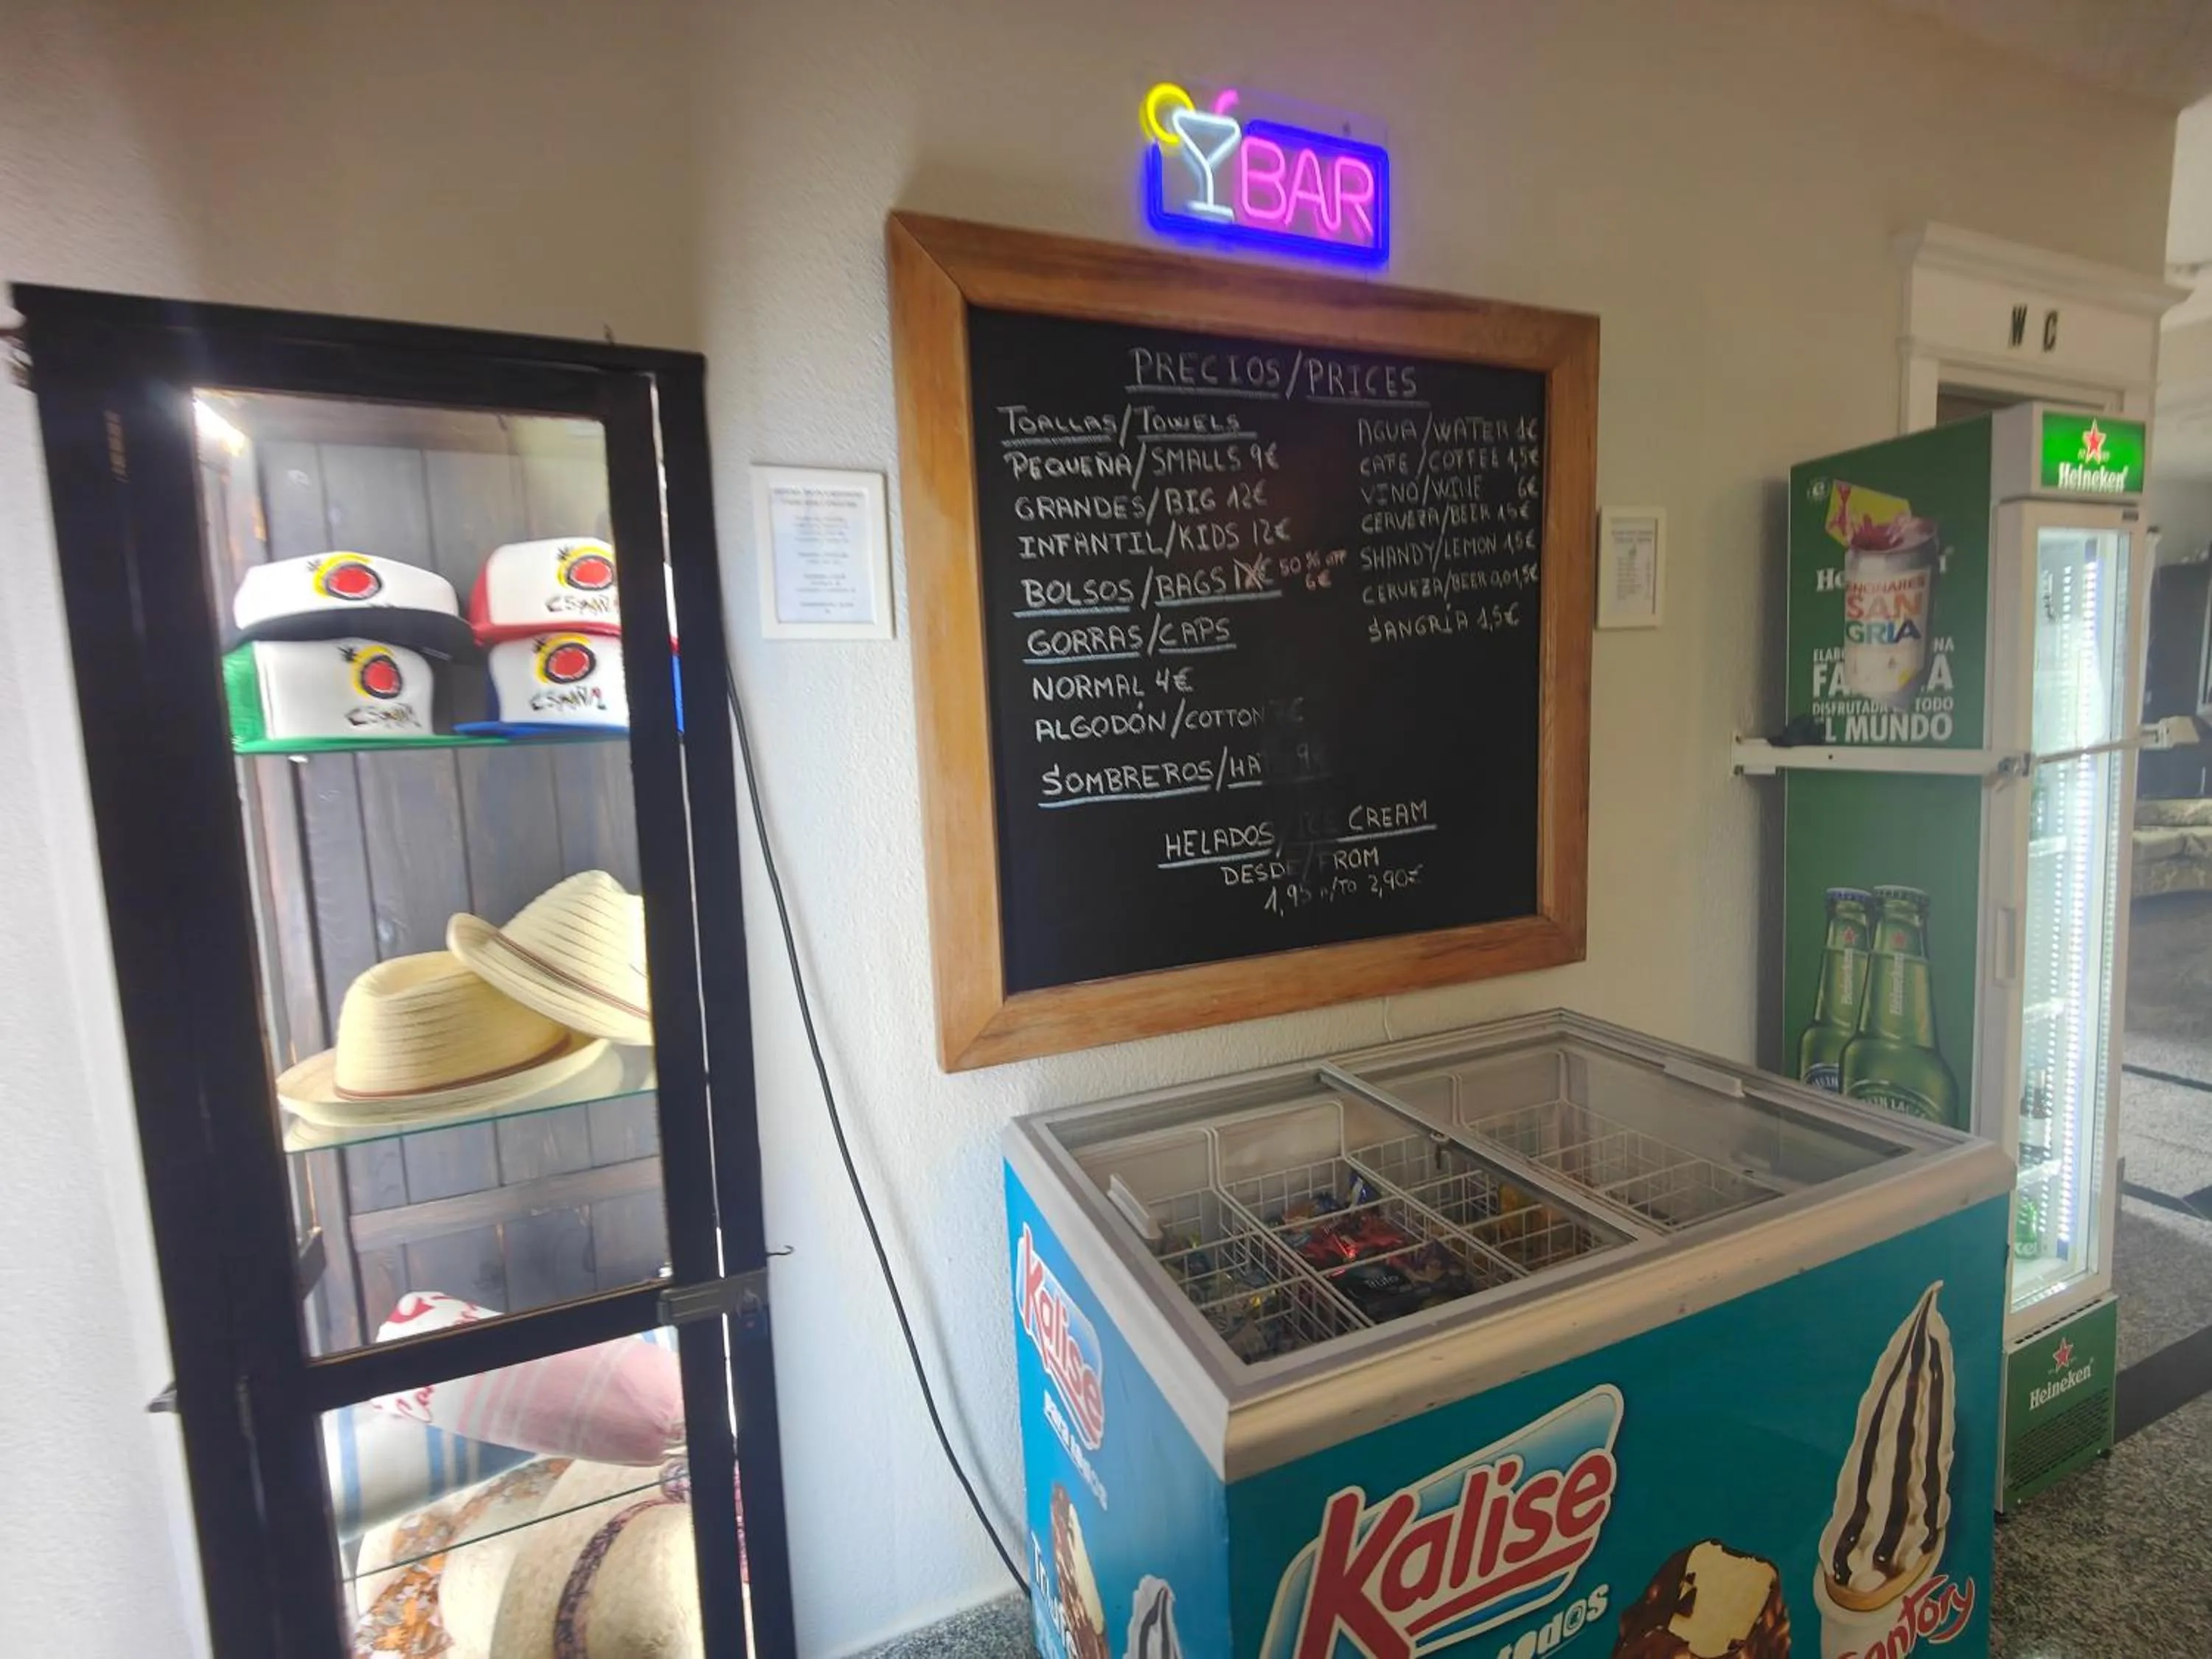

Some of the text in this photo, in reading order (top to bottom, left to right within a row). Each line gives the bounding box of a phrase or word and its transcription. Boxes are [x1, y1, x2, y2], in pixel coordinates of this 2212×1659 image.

[1240, 136, 1374, 237] BAR
[1251, 442, 1280, 471] 9€
[2059, 462, 2129, 493] Heineken
[1227, 480, 1267, 512] 12€
[1253, 517, 1292, 548] 12€
[1477, 601, 1520, 633] 1,5€
[1847, 591, 1924, 622] SAN
[1033, 667, 1194, 701] NORMAL 4€
[1845, 712, 1954, 744] MUNDO
[1042, 745, 1270, 795] SOMBREROS/HA
[1349, 800, 1428, 831] CREAM
[1023, 1227, 1103, 1432] Kalise
[2028, 1363, 2093, 1411] Heineken
[1296, 1453, 1613, 1659] Kalise
[1834, 1574, 1975, 1659] antory
